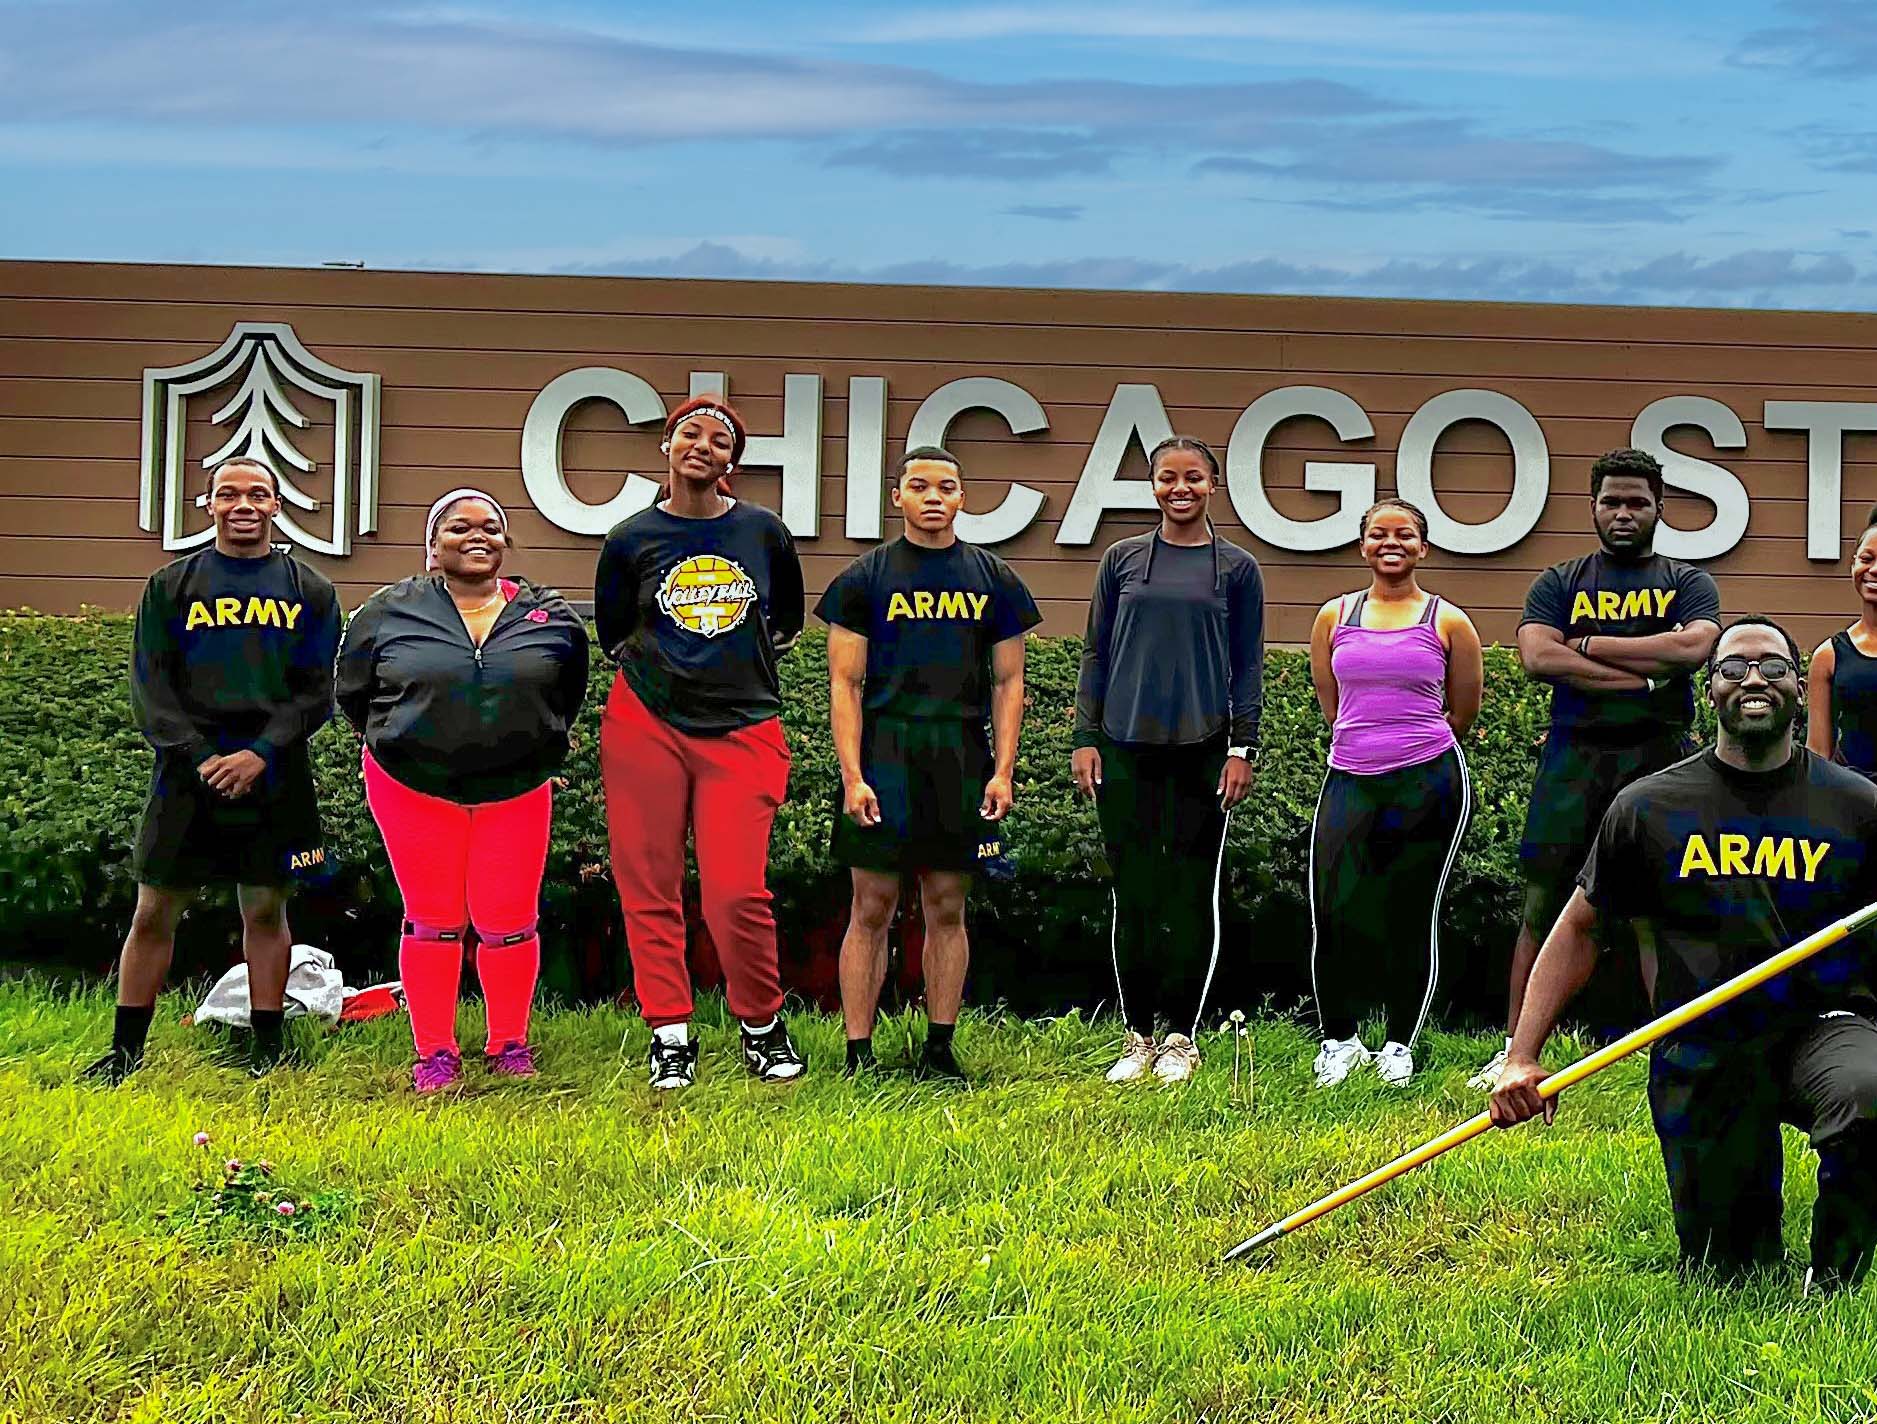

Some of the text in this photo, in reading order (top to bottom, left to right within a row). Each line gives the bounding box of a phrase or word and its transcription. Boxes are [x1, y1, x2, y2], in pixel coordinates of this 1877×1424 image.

[520, 366, 1550, 556] CHICAGO
[185, 596, 302, 632] ARMY
[886, 590, 990, 622] ARMY
[1570, 588, 1677, 624] ARMY
[290, 847, 325, 870] ARM
[977, 841, 1001, 859] ARM
[1678, 832, 1831, 882] ARMY
